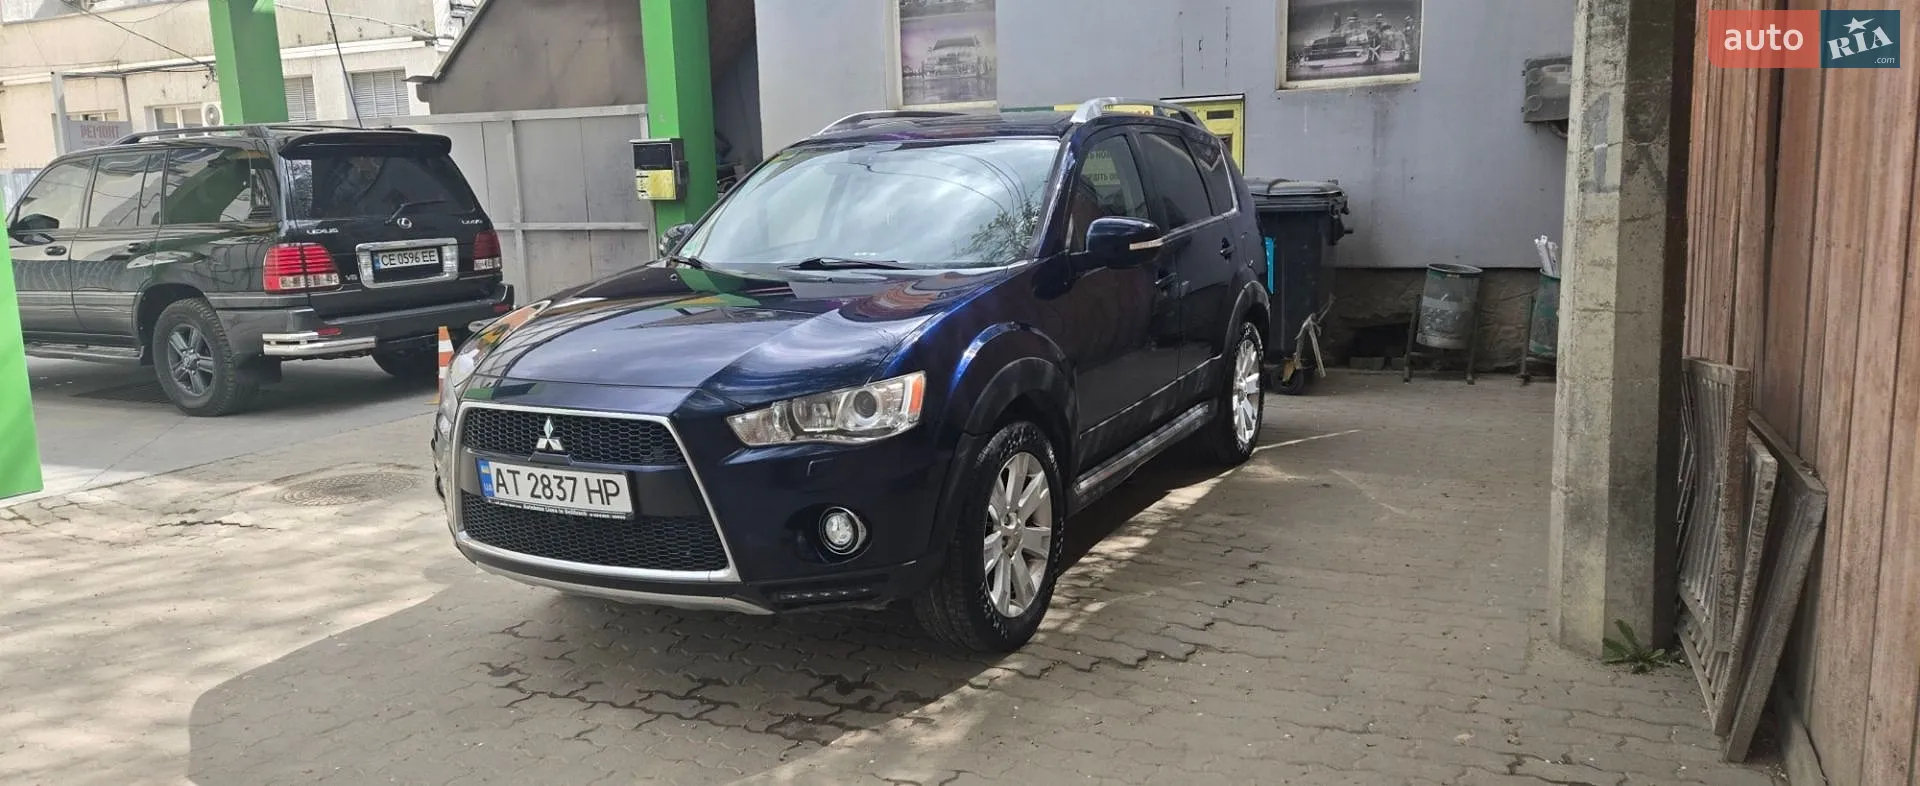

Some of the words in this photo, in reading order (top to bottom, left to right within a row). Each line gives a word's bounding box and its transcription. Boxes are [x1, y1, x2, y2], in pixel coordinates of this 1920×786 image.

[381, 253, 396, 266] CE
[397, 251, 421, 264] 0596
[422, 250, 437, 262] EE
[496, 468, 520, 496] AT
[527, 472, 577, 502] 2837
[584, 477, 620, 506] HP
